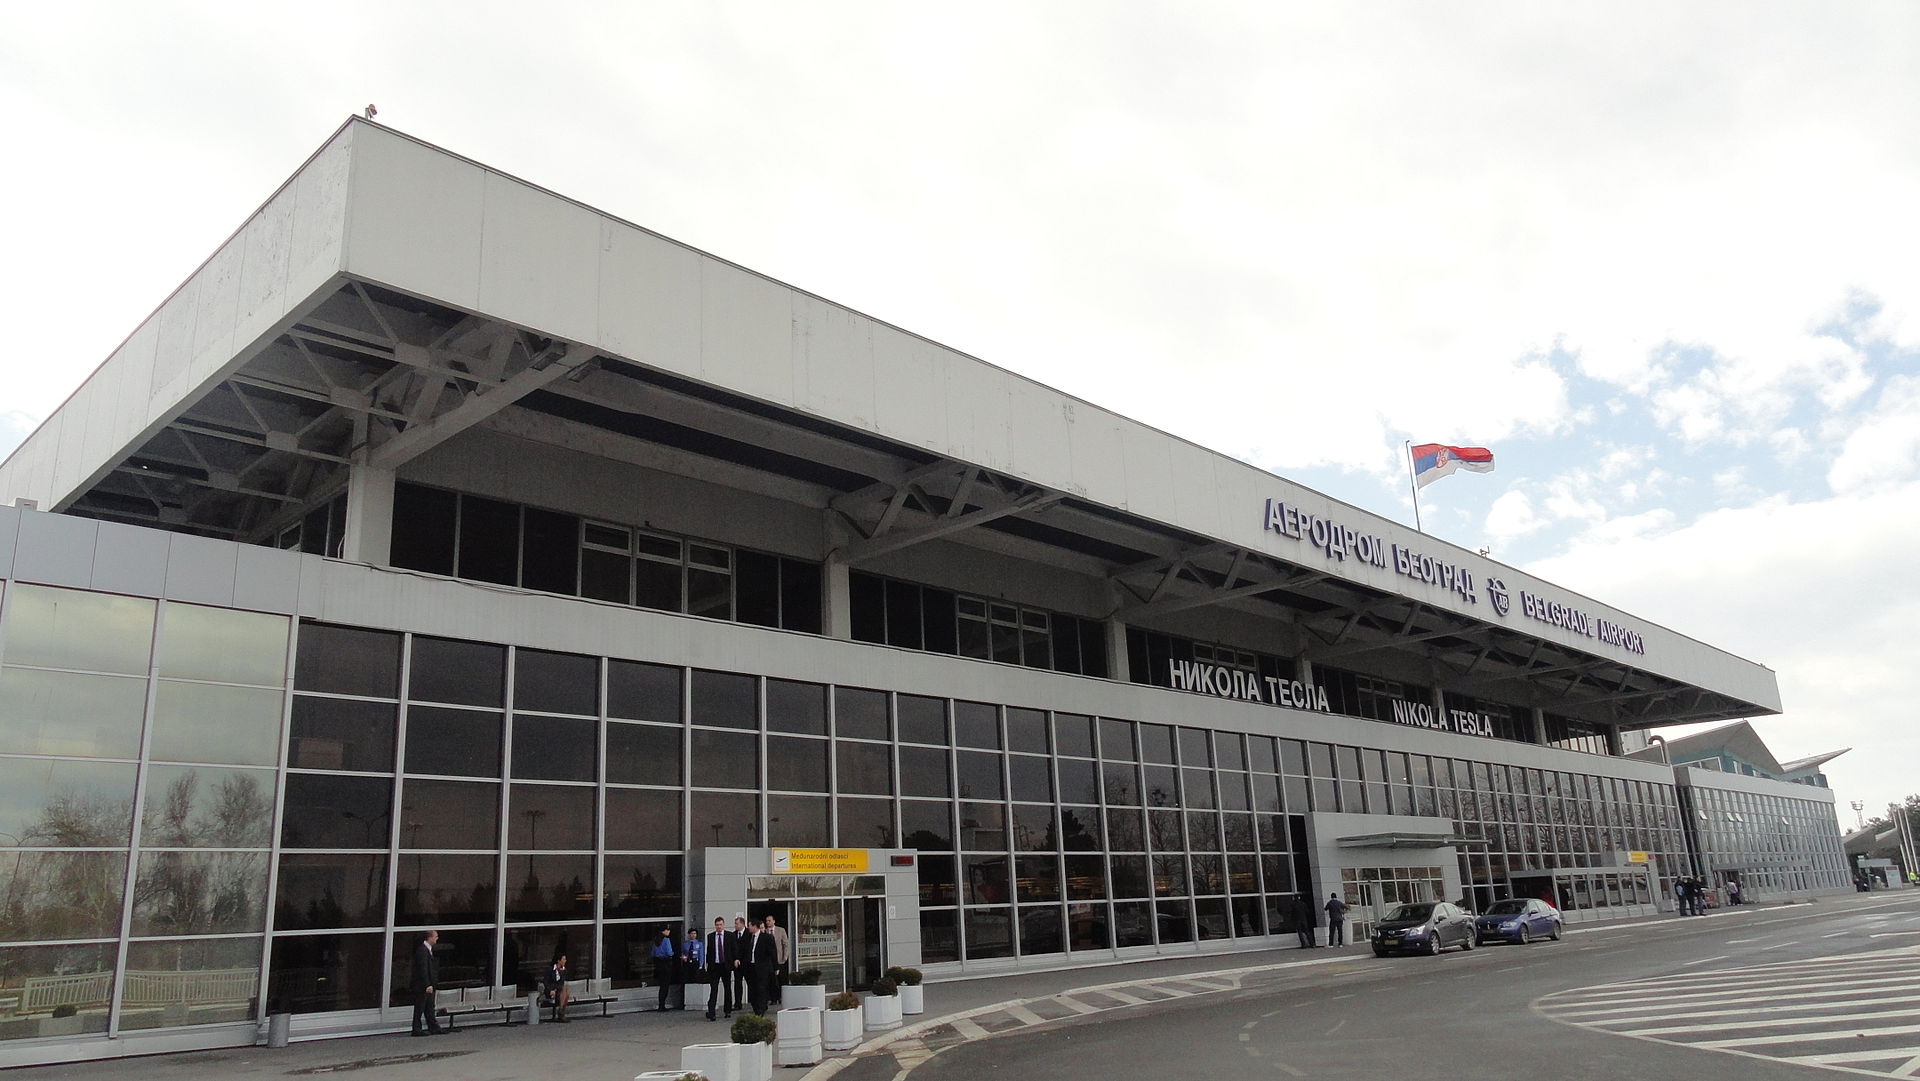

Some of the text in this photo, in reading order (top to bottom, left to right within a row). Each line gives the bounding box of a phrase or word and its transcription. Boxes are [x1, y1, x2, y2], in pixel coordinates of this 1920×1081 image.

[1264, 498, 1477, 604] АЕРОДРОМ БЕОГРАД
[1520, 590, 1646, 655] BELGRADE AIRPORT
[1169, 658, 1331, 712] НИКОЛА ТЕСЛА
[1392, 699, 1494, 737] NIKOLA TESLA
[828, 862, 857, 870] departures
